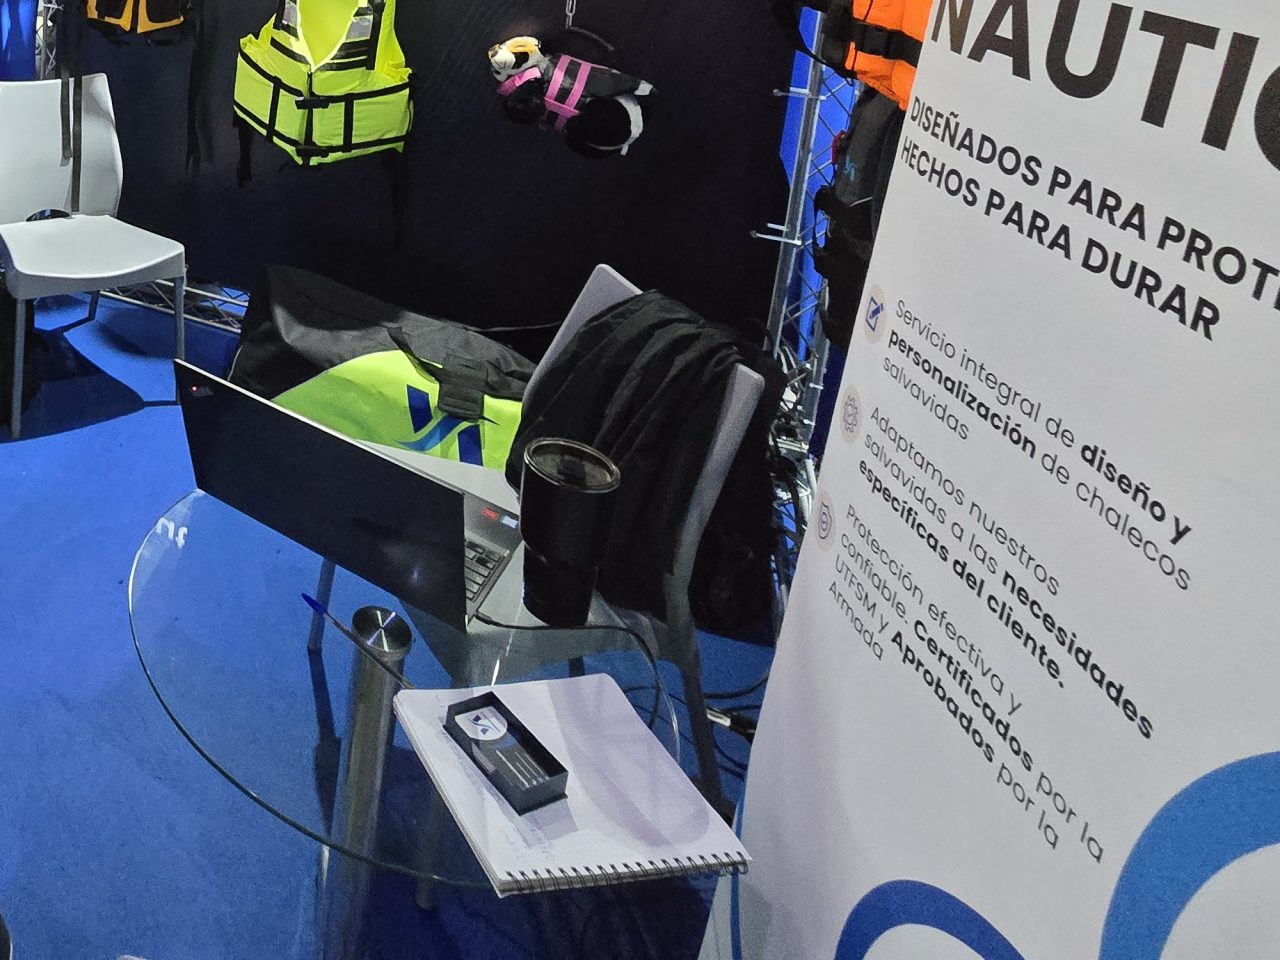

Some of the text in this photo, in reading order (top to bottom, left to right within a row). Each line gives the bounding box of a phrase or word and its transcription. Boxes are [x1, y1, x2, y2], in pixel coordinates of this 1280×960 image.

[901, 136, 1220, 341] HECHOS PARA DURAR
[910, 95, 1043, 187] DISEÑADOS
[1047, 165, 1147, 241] PARA
[870, 407, 1060, 596] Adaptamos nuestros
[883, 356, 969, 441] salvavidas
[888, 328, 1191, 591] personalización de chalecos
[896, 299, 1192, 545] Servicio integral de diseño y
[828, 580, 884, 661] Armada
[846, 504, 1022, 716] Protección efectiva y
[859, 459, 1064, 688] específicas del cliente.
[864, 433, 1153, 740] salvavidas a las necesidades
[835, 554, 1059, 850] UTFSM y Aprobados por la
[840, 533, 1104, 864] confiable. Certificados por la
